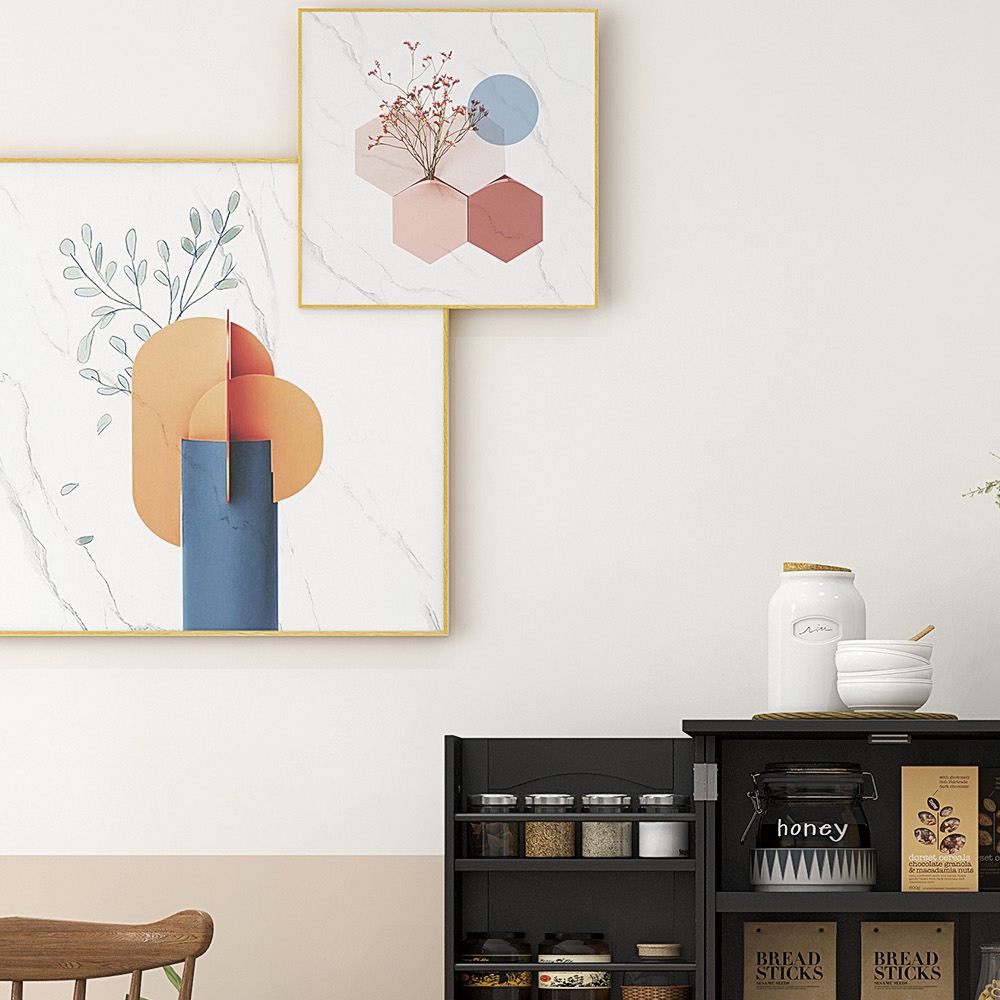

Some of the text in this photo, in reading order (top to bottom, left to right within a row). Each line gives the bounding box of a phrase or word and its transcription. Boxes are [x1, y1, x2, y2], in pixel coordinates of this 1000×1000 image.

[777, 818, 849, 842] honey
[908, 853, 971, 861] dorset cereals
[756, 951, 821, 966] BREAD
[874, 951, 938, 966] BREAD
[756, 966, 824, 980] STICKS
[874, 966, 942, 980] STICKS
